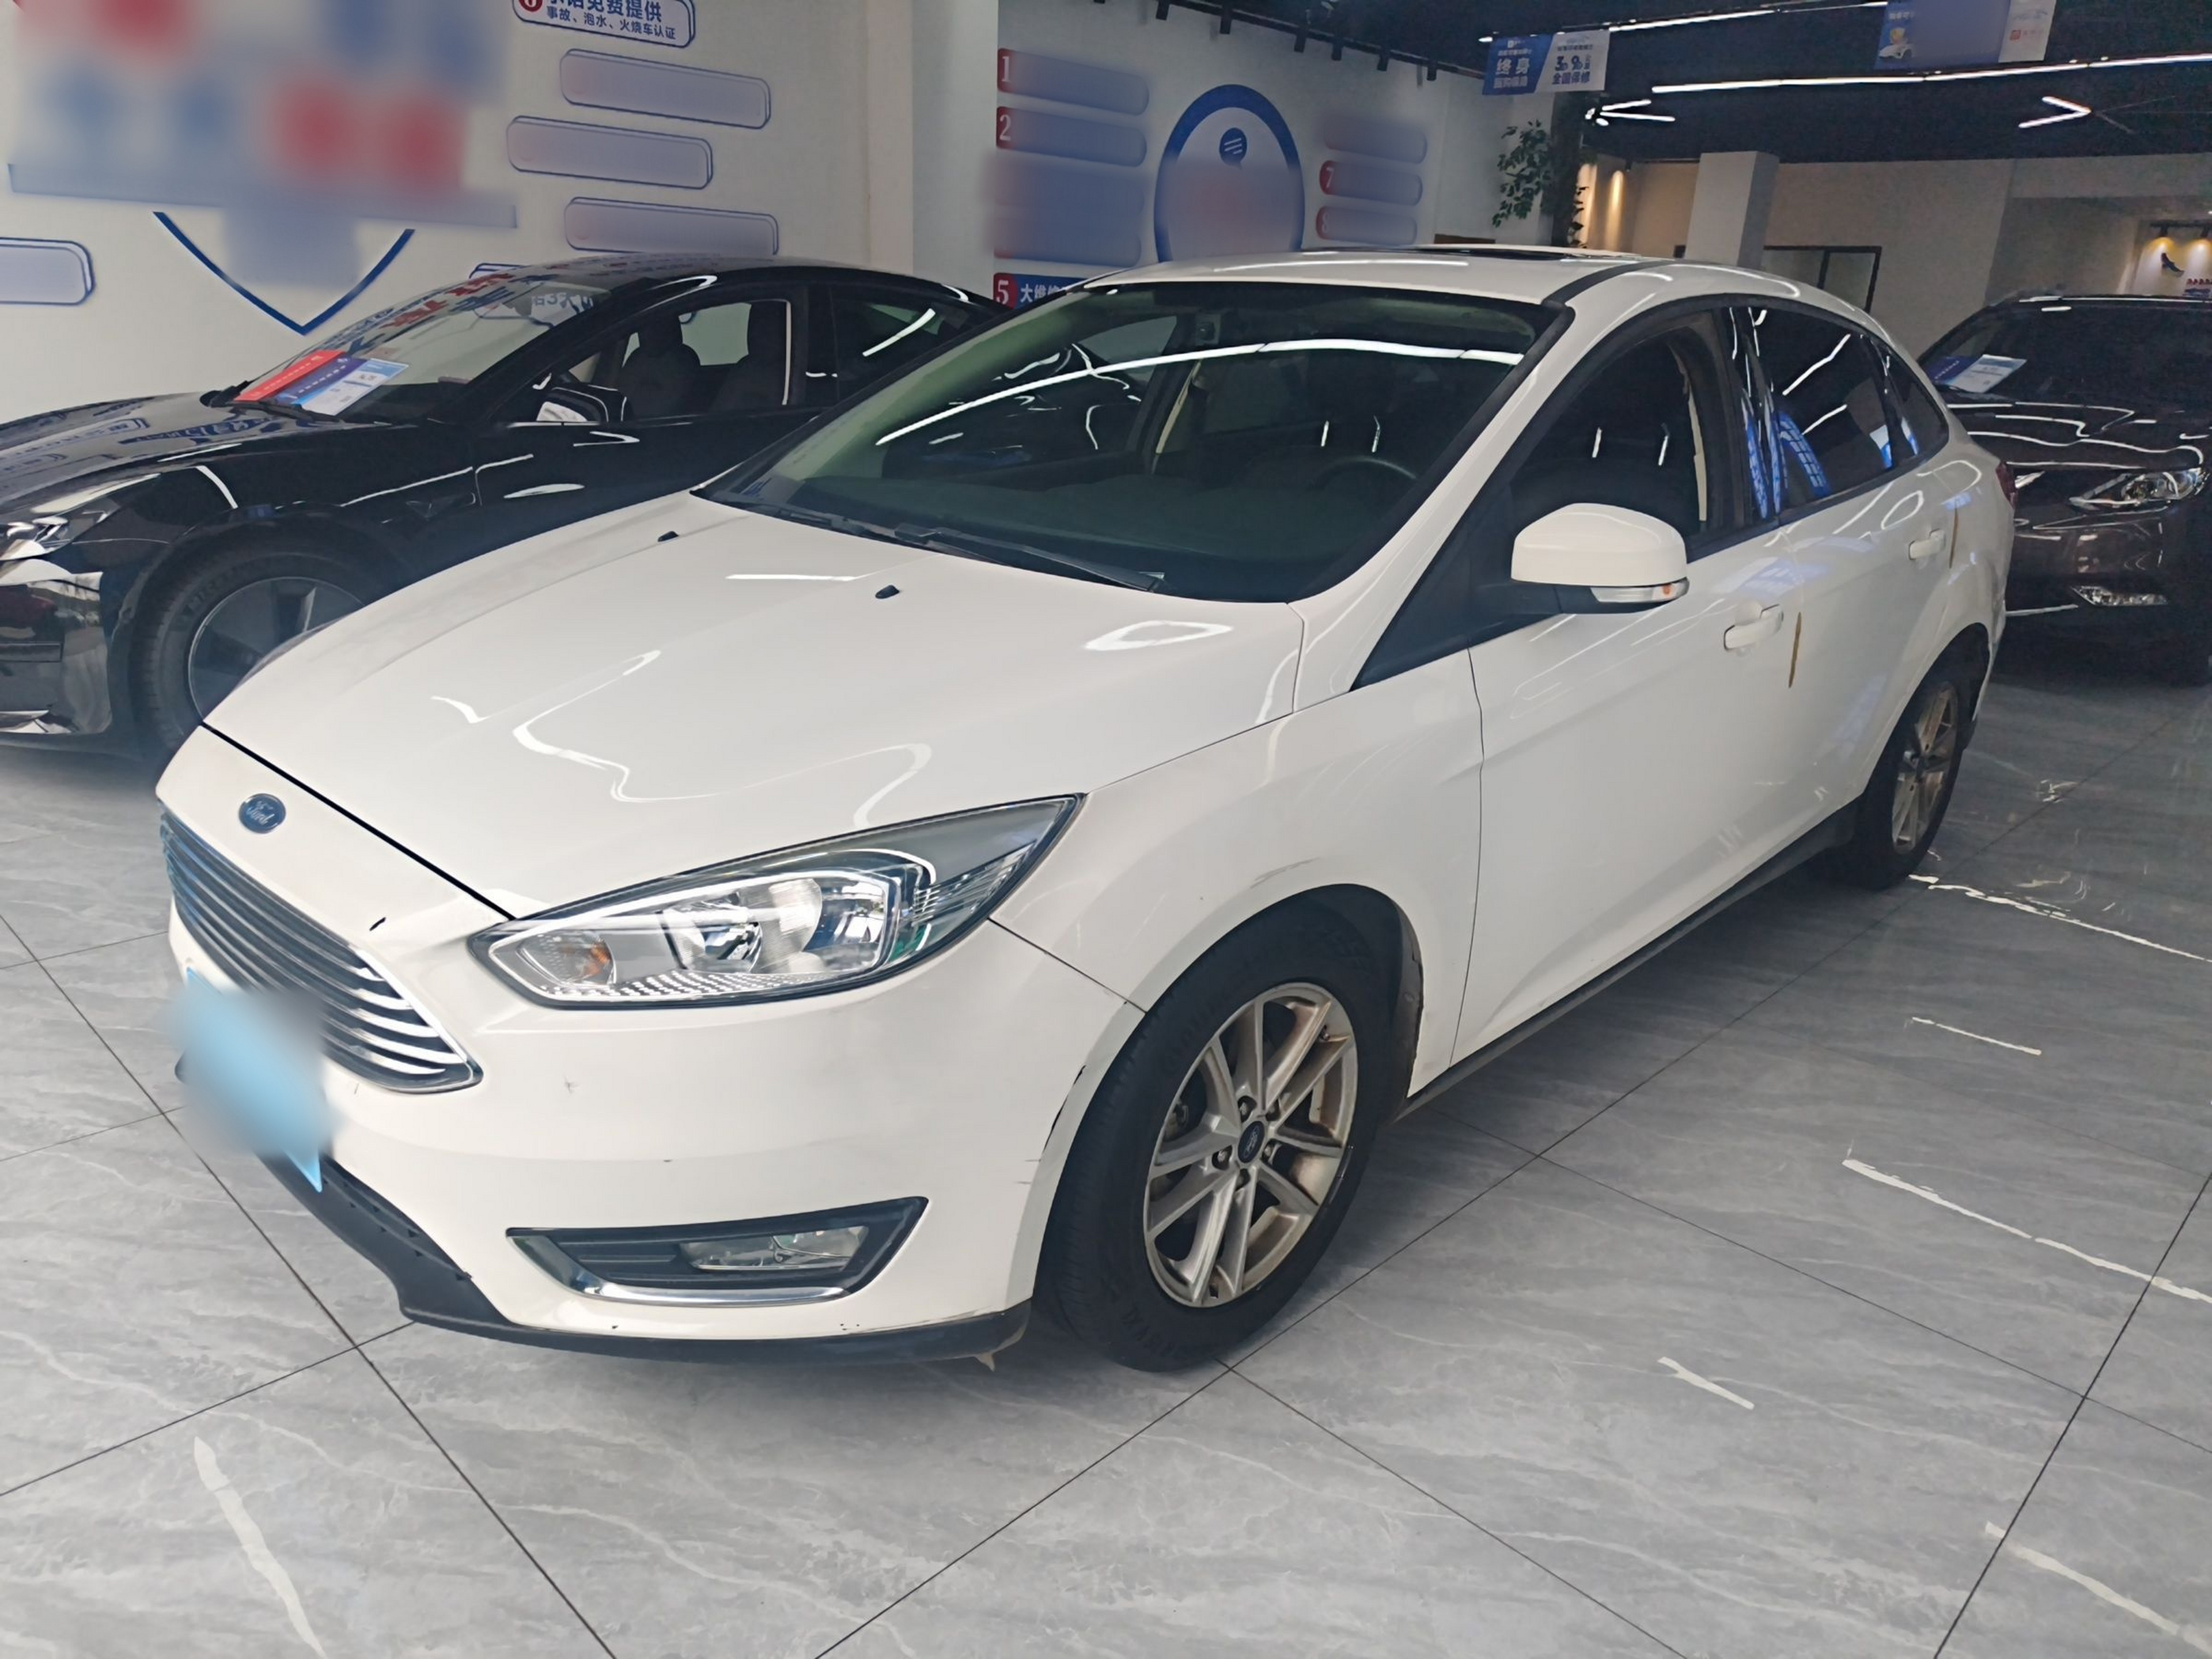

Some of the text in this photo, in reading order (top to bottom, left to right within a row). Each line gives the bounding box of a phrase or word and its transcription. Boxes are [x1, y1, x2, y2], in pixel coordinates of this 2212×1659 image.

[546, 0, 662, 22] 免费提供
[547, 6, 676, 39] 事故、泡水、火烧车认证
[1001, 56, 1010, 82] 1
[999, 115, 1012, 141] 2
[996, 279, 1009, 305] 5
